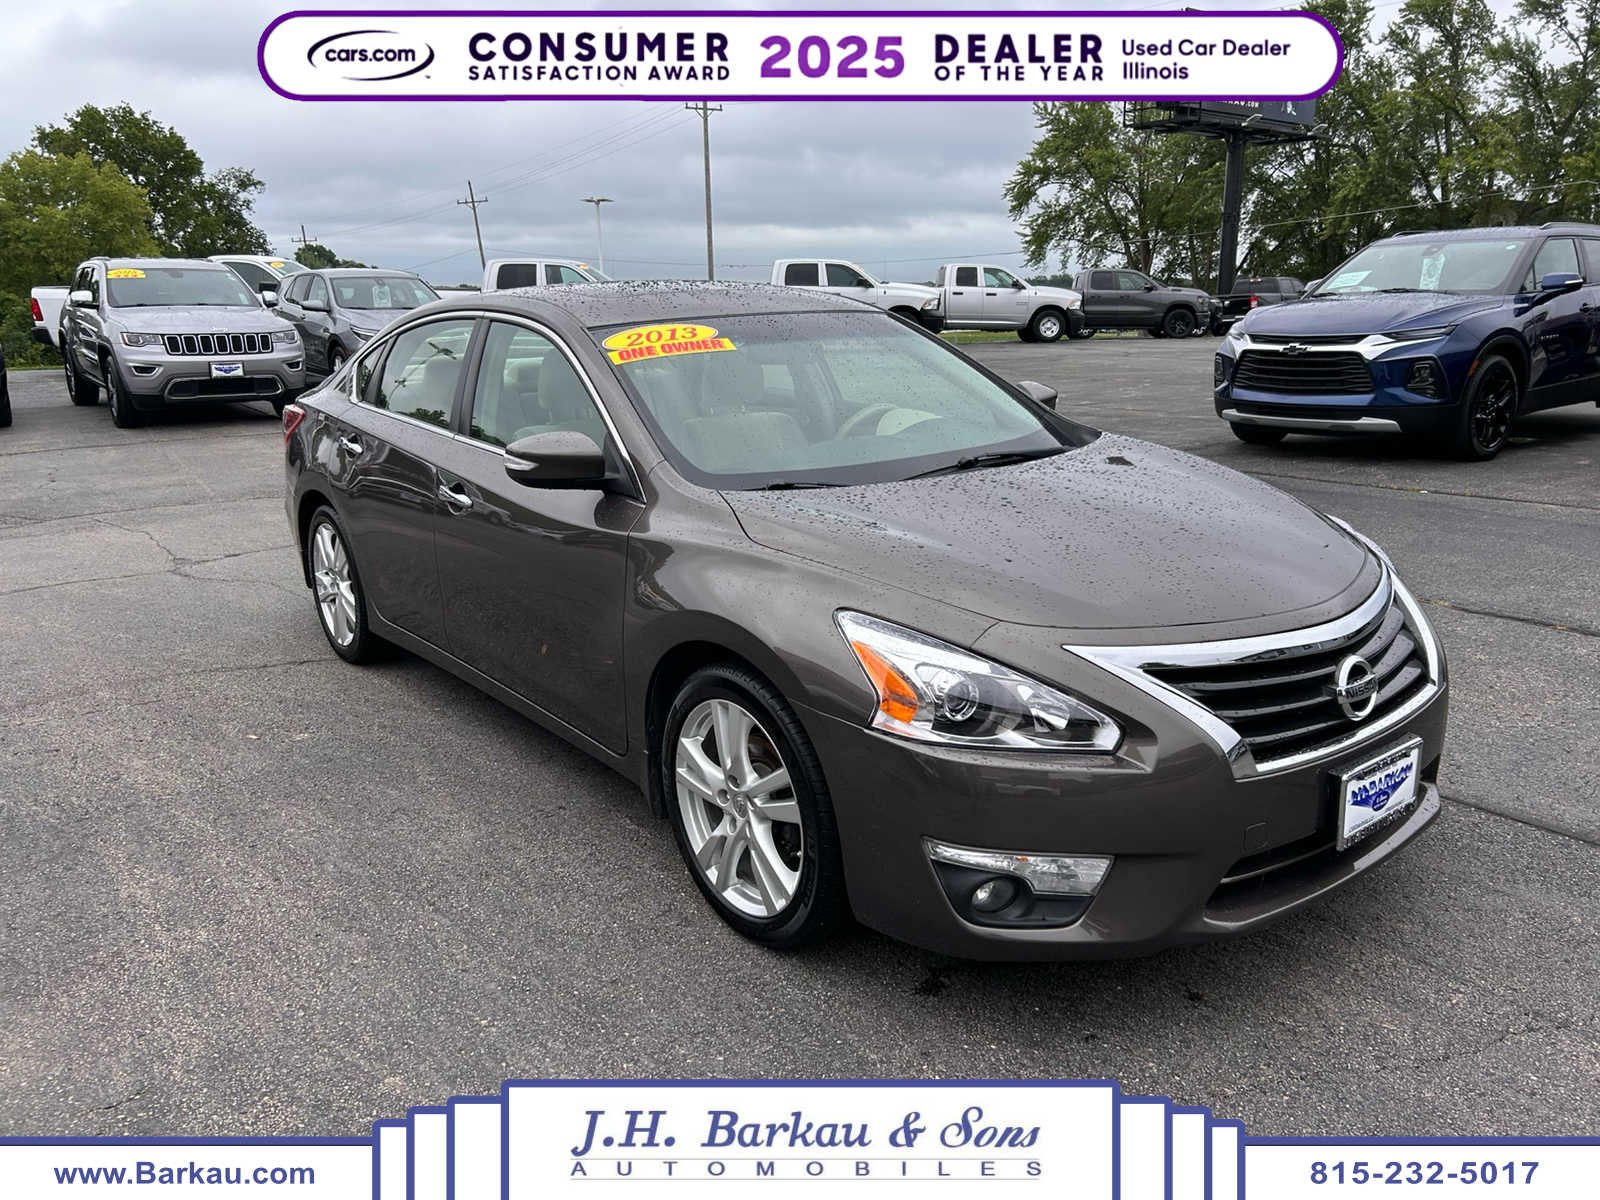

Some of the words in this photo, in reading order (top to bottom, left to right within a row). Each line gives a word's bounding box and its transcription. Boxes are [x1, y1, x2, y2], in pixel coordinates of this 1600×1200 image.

[627, 328, 698, 346] 2013
[618, 345, 656, 361] ONE
[660, 339, 724, 353] OWNER
